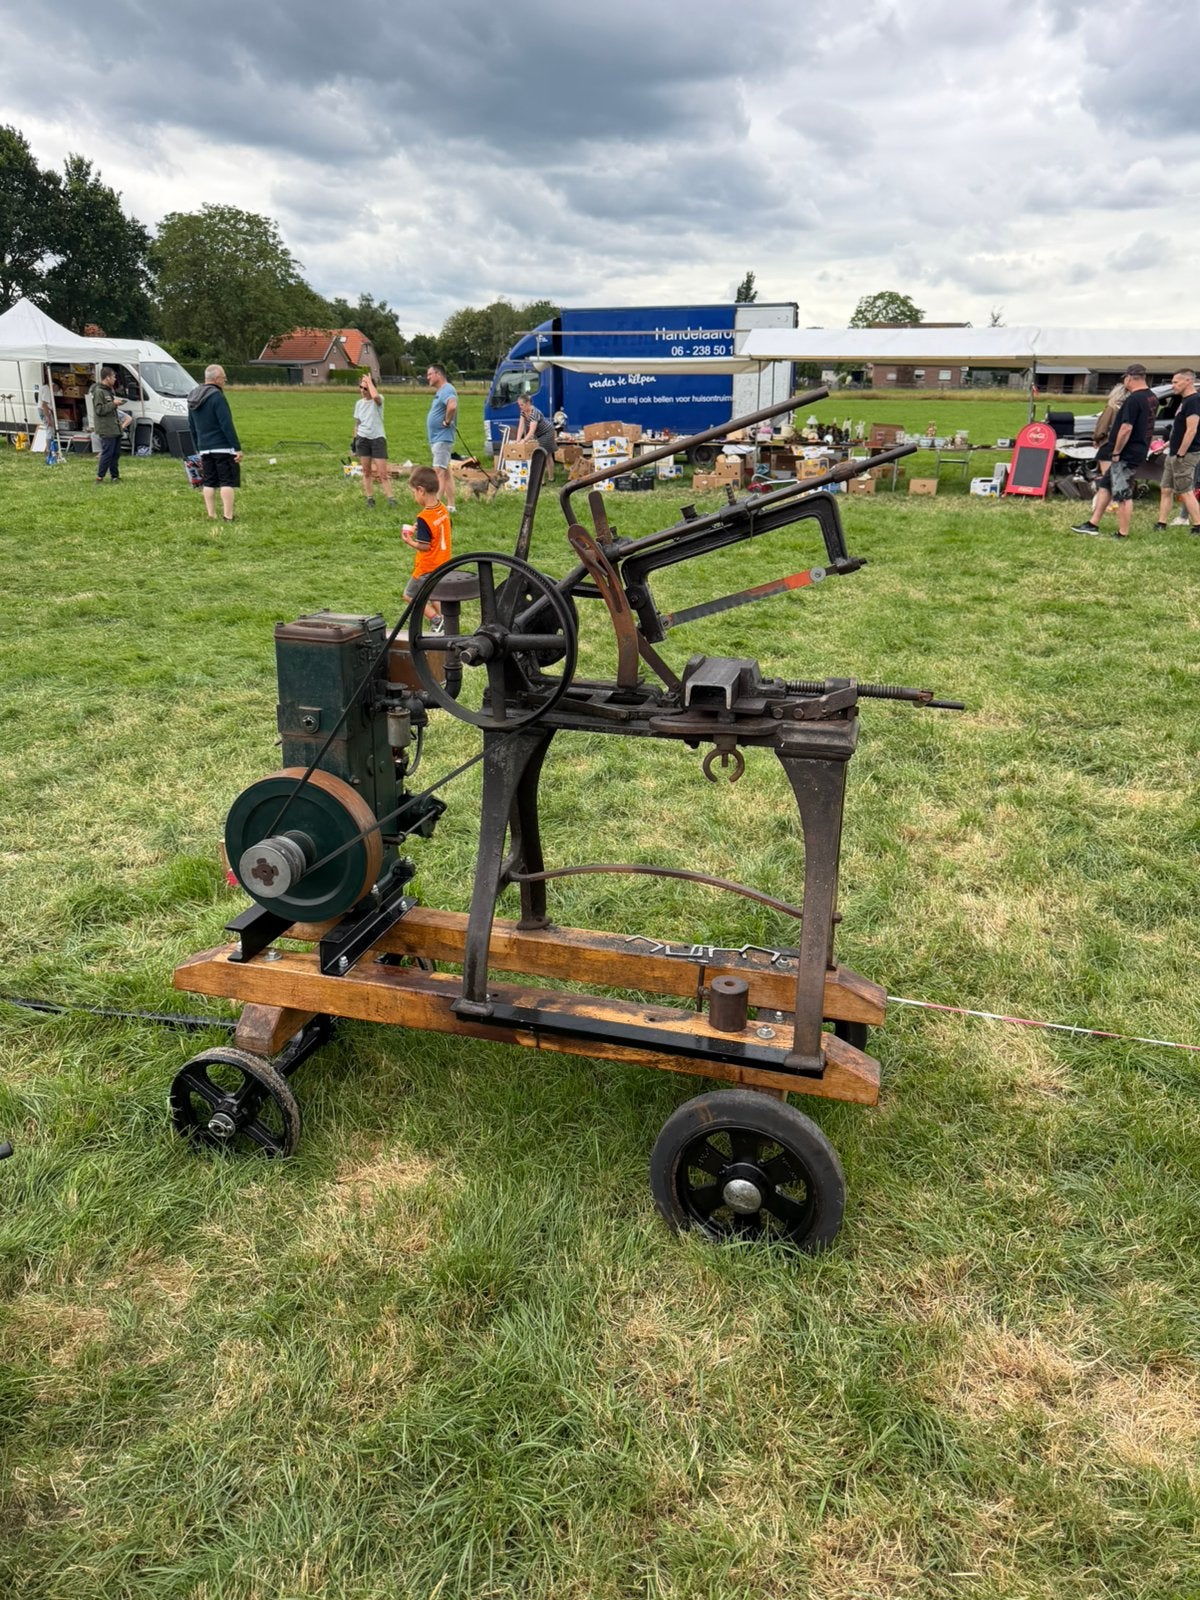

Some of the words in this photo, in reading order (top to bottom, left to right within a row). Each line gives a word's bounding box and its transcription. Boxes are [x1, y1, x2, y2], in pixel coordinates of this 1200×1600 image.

[671, 345, 684, 356] 06
[692, 345, 711, 356] 238
[713, 345, 726, 356] 50
[604, 396, 611, 404] U
[612, 396, 627, 404] kunt
[628, 396, 638, 405] mij
[639, 396, 652, 404] ook
[653, 395, 674, 404] bellen
